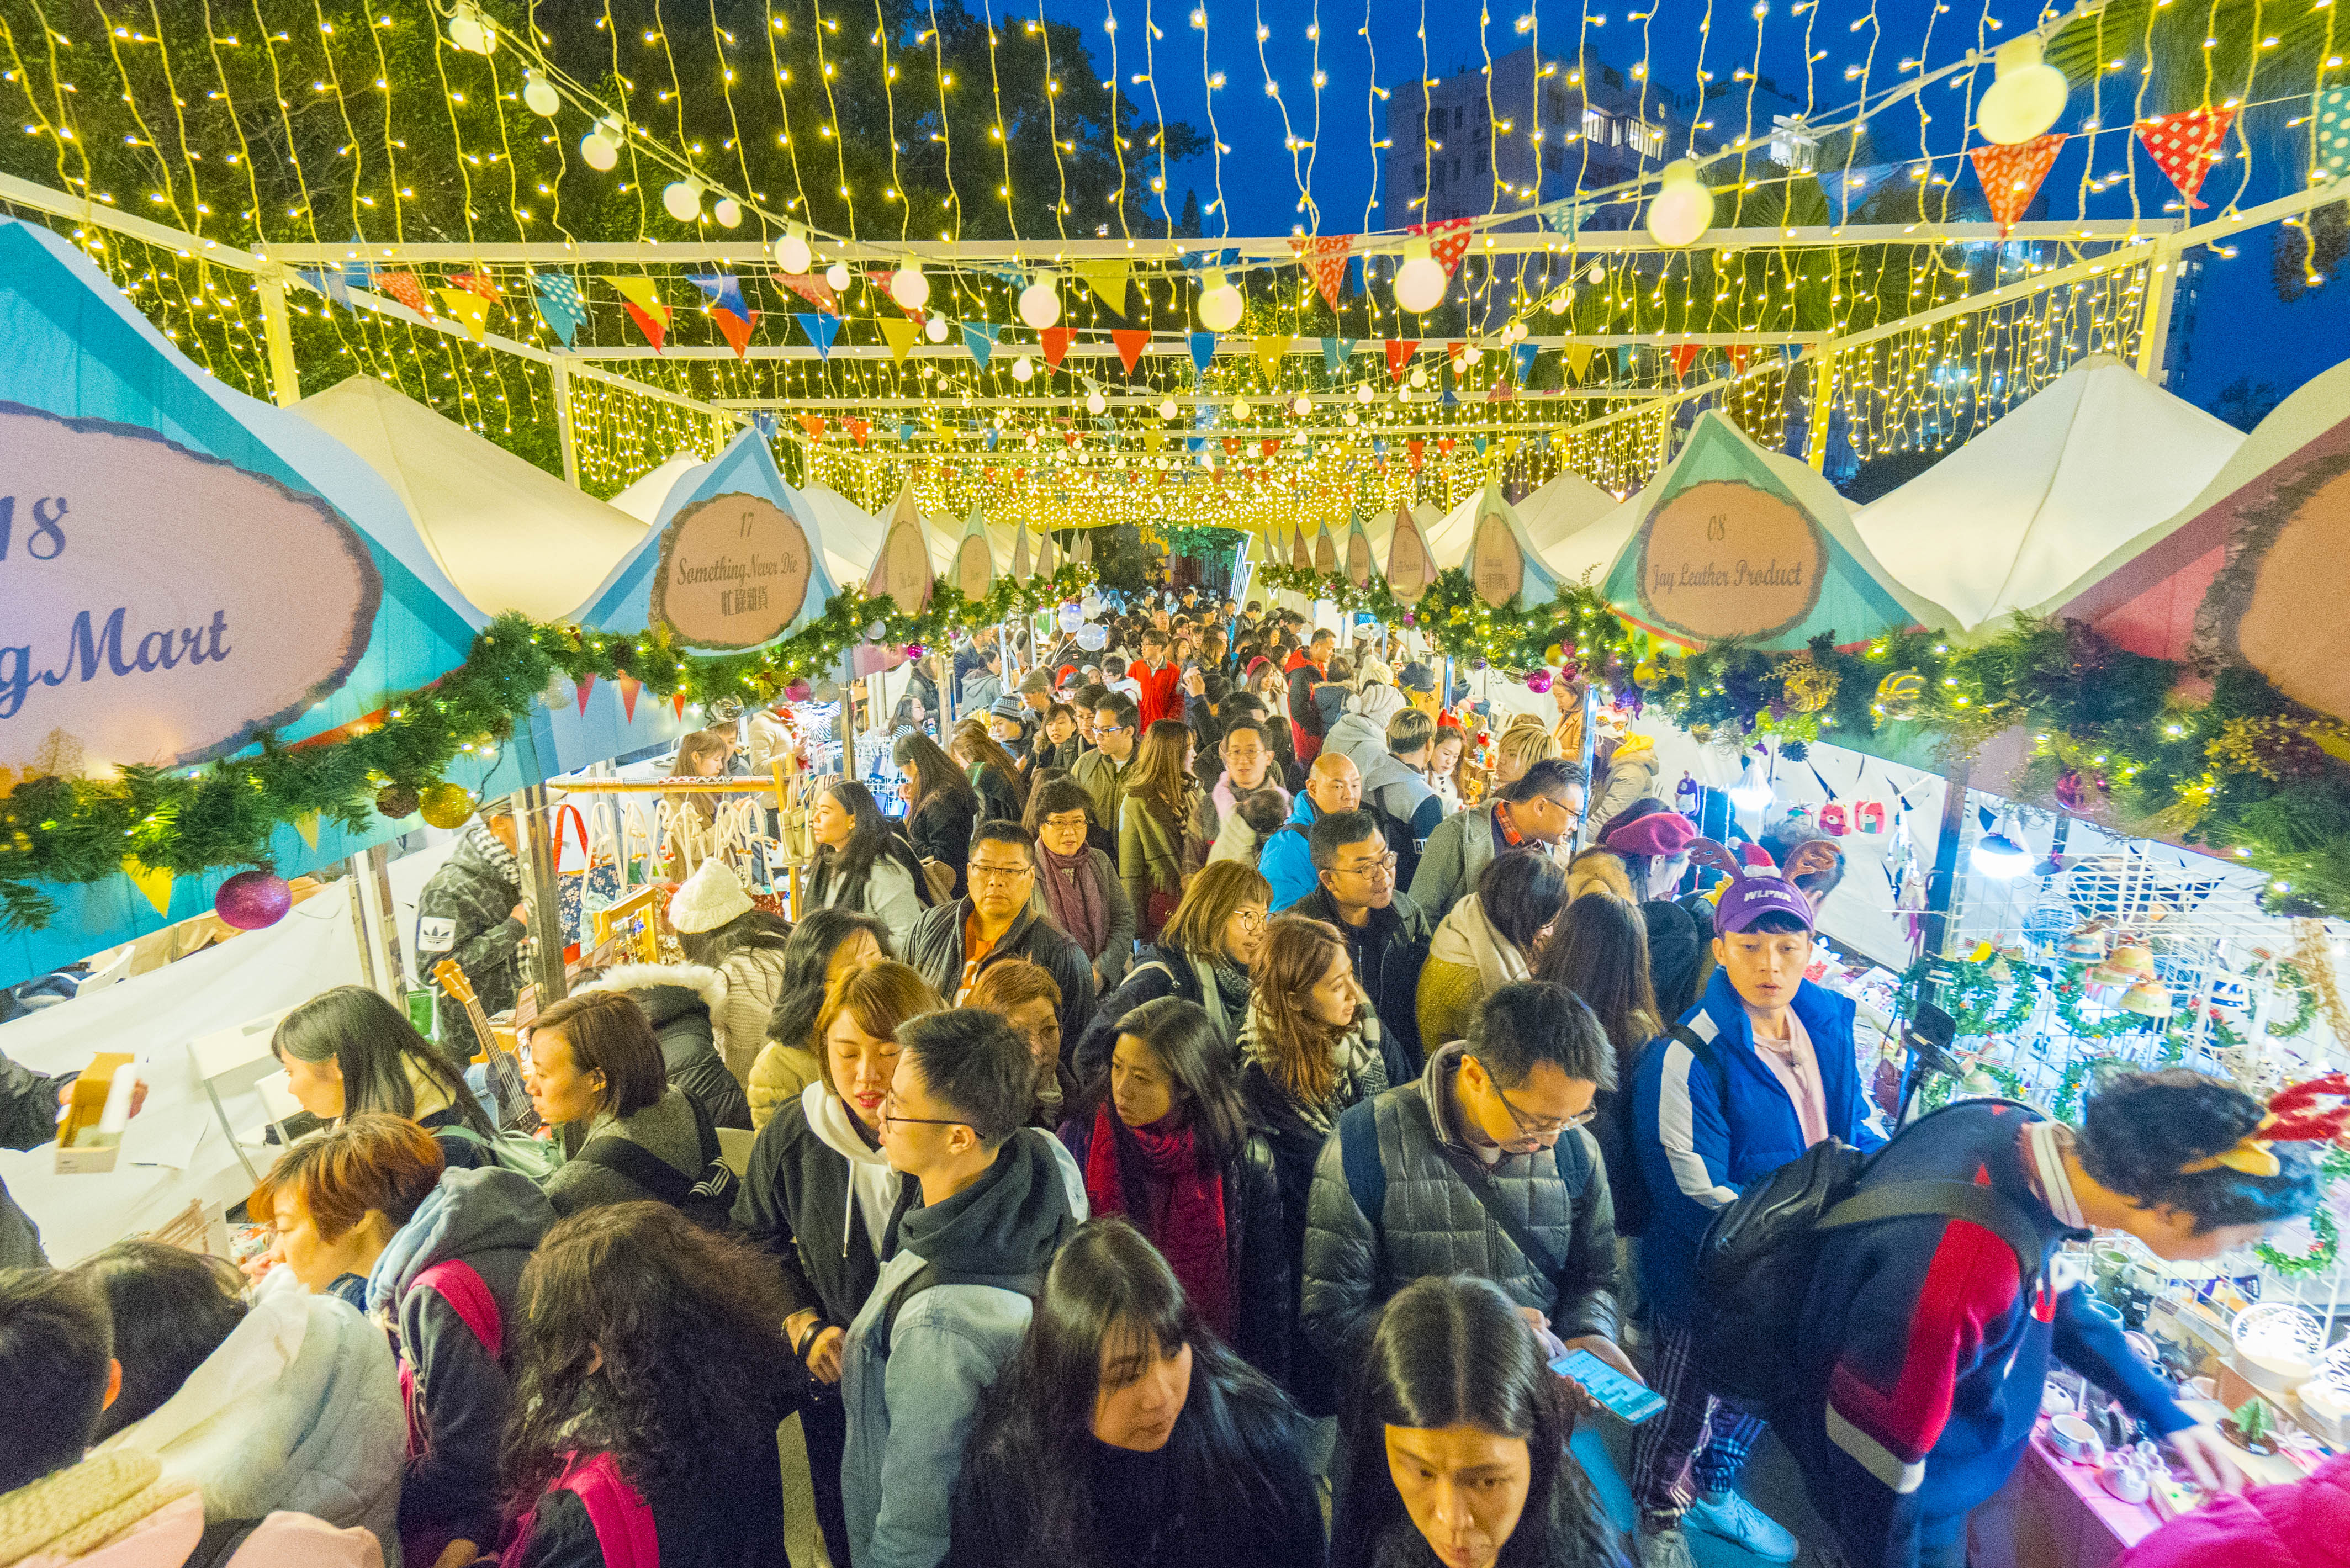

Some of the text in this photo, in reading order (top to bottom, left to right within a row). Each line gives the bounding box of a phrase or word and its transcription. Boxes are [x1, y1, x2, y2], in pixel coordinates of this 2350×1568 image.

[739, 512, 755, 538] 17
[1706, 513, 1727, 541] 08
[677, 552, 798, 587] Something Never Die
[1652, 559, 1802, 595] Jay Leather Product
